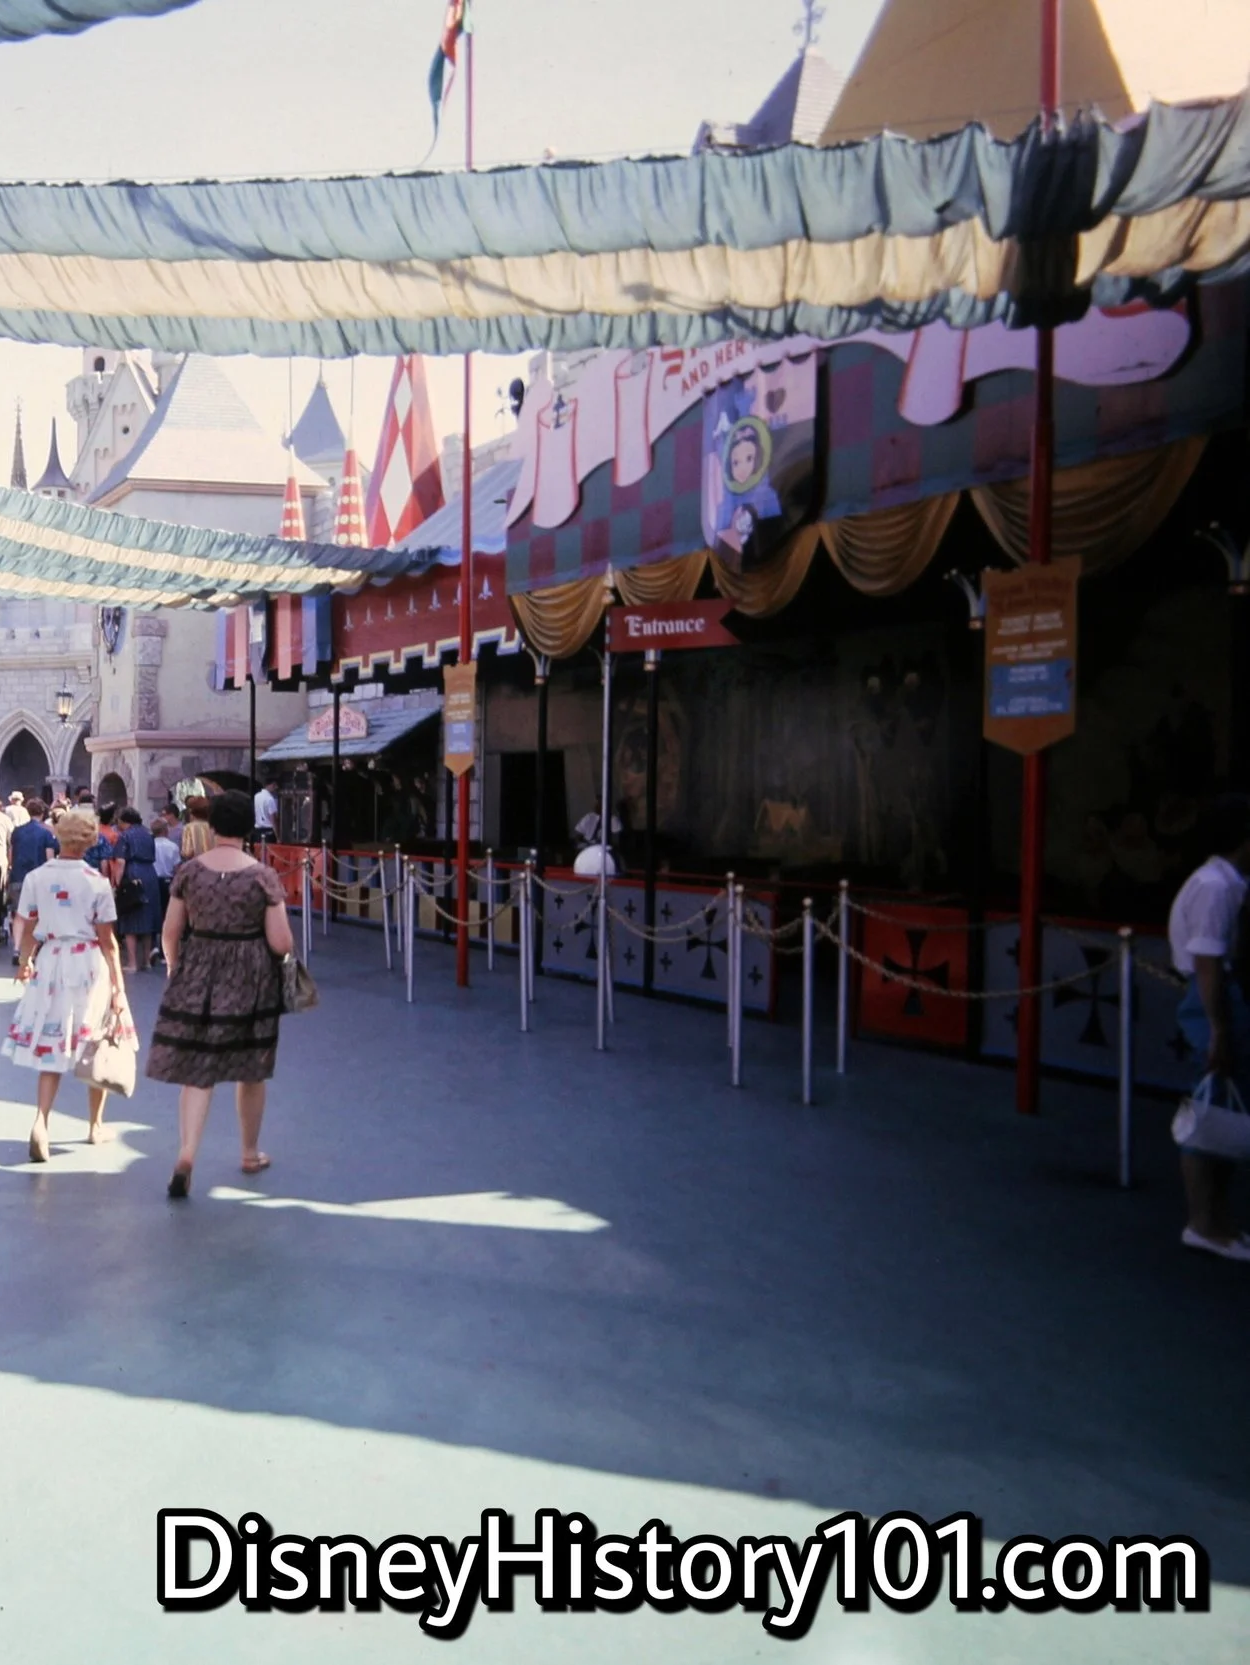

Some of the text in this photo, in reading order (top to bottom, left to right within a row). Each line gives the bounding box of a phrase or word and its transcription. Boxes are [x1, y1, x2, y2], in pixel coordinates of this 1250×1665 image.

[681, 361, 710, 397] AND
[715, 340, 745, 367] HER
[623, 613, 706, 637] Entrance
